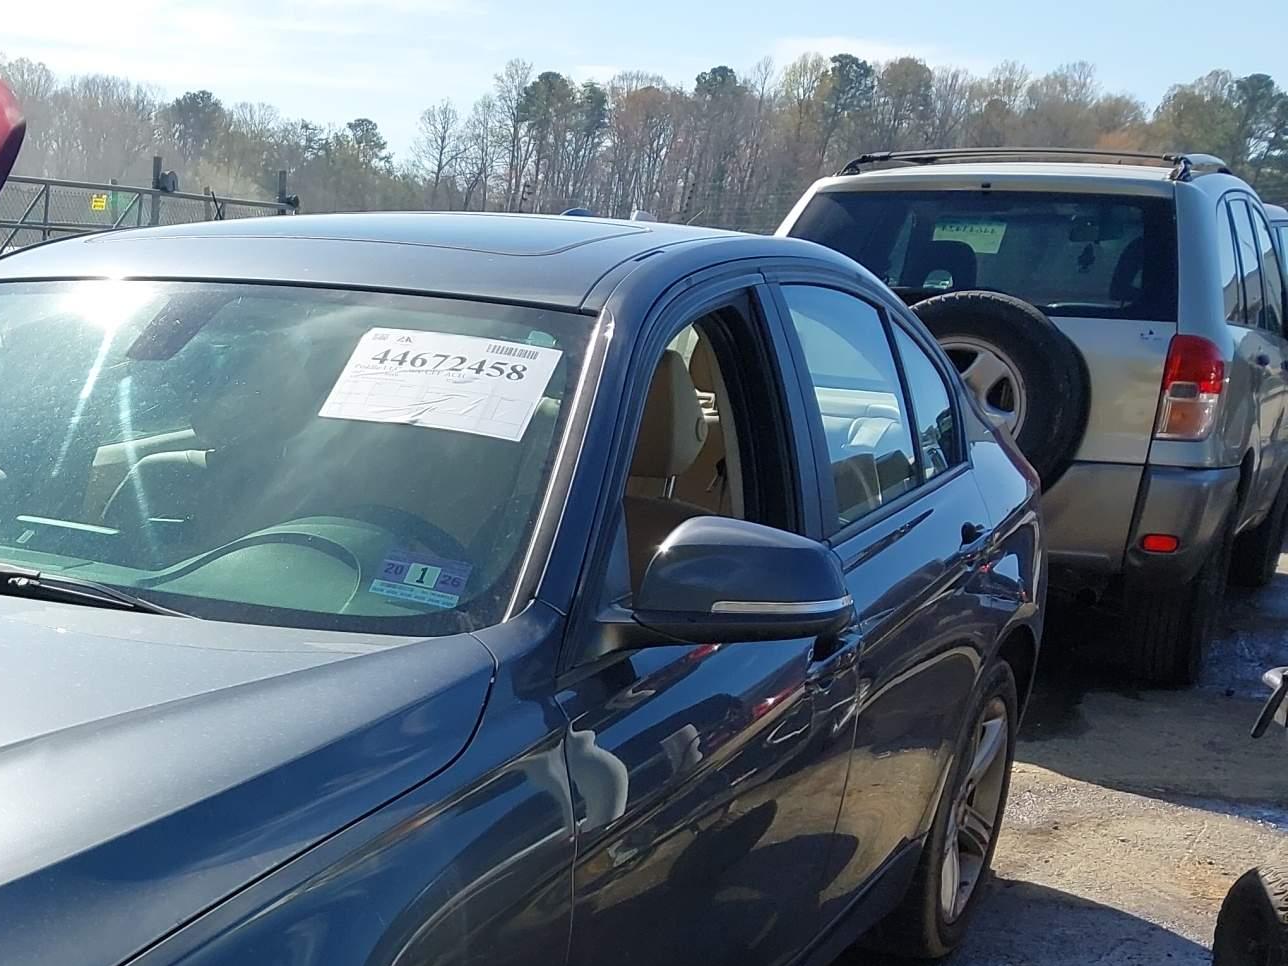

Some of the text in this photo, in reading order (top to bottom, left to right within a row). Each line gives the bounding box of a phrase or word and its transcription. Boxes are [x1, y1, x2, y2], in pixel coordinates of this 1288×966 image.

[371, 348, 528, 381] 44672458
[384, 562, 404, 576] 20
[415, 567, 428, 584] 1
